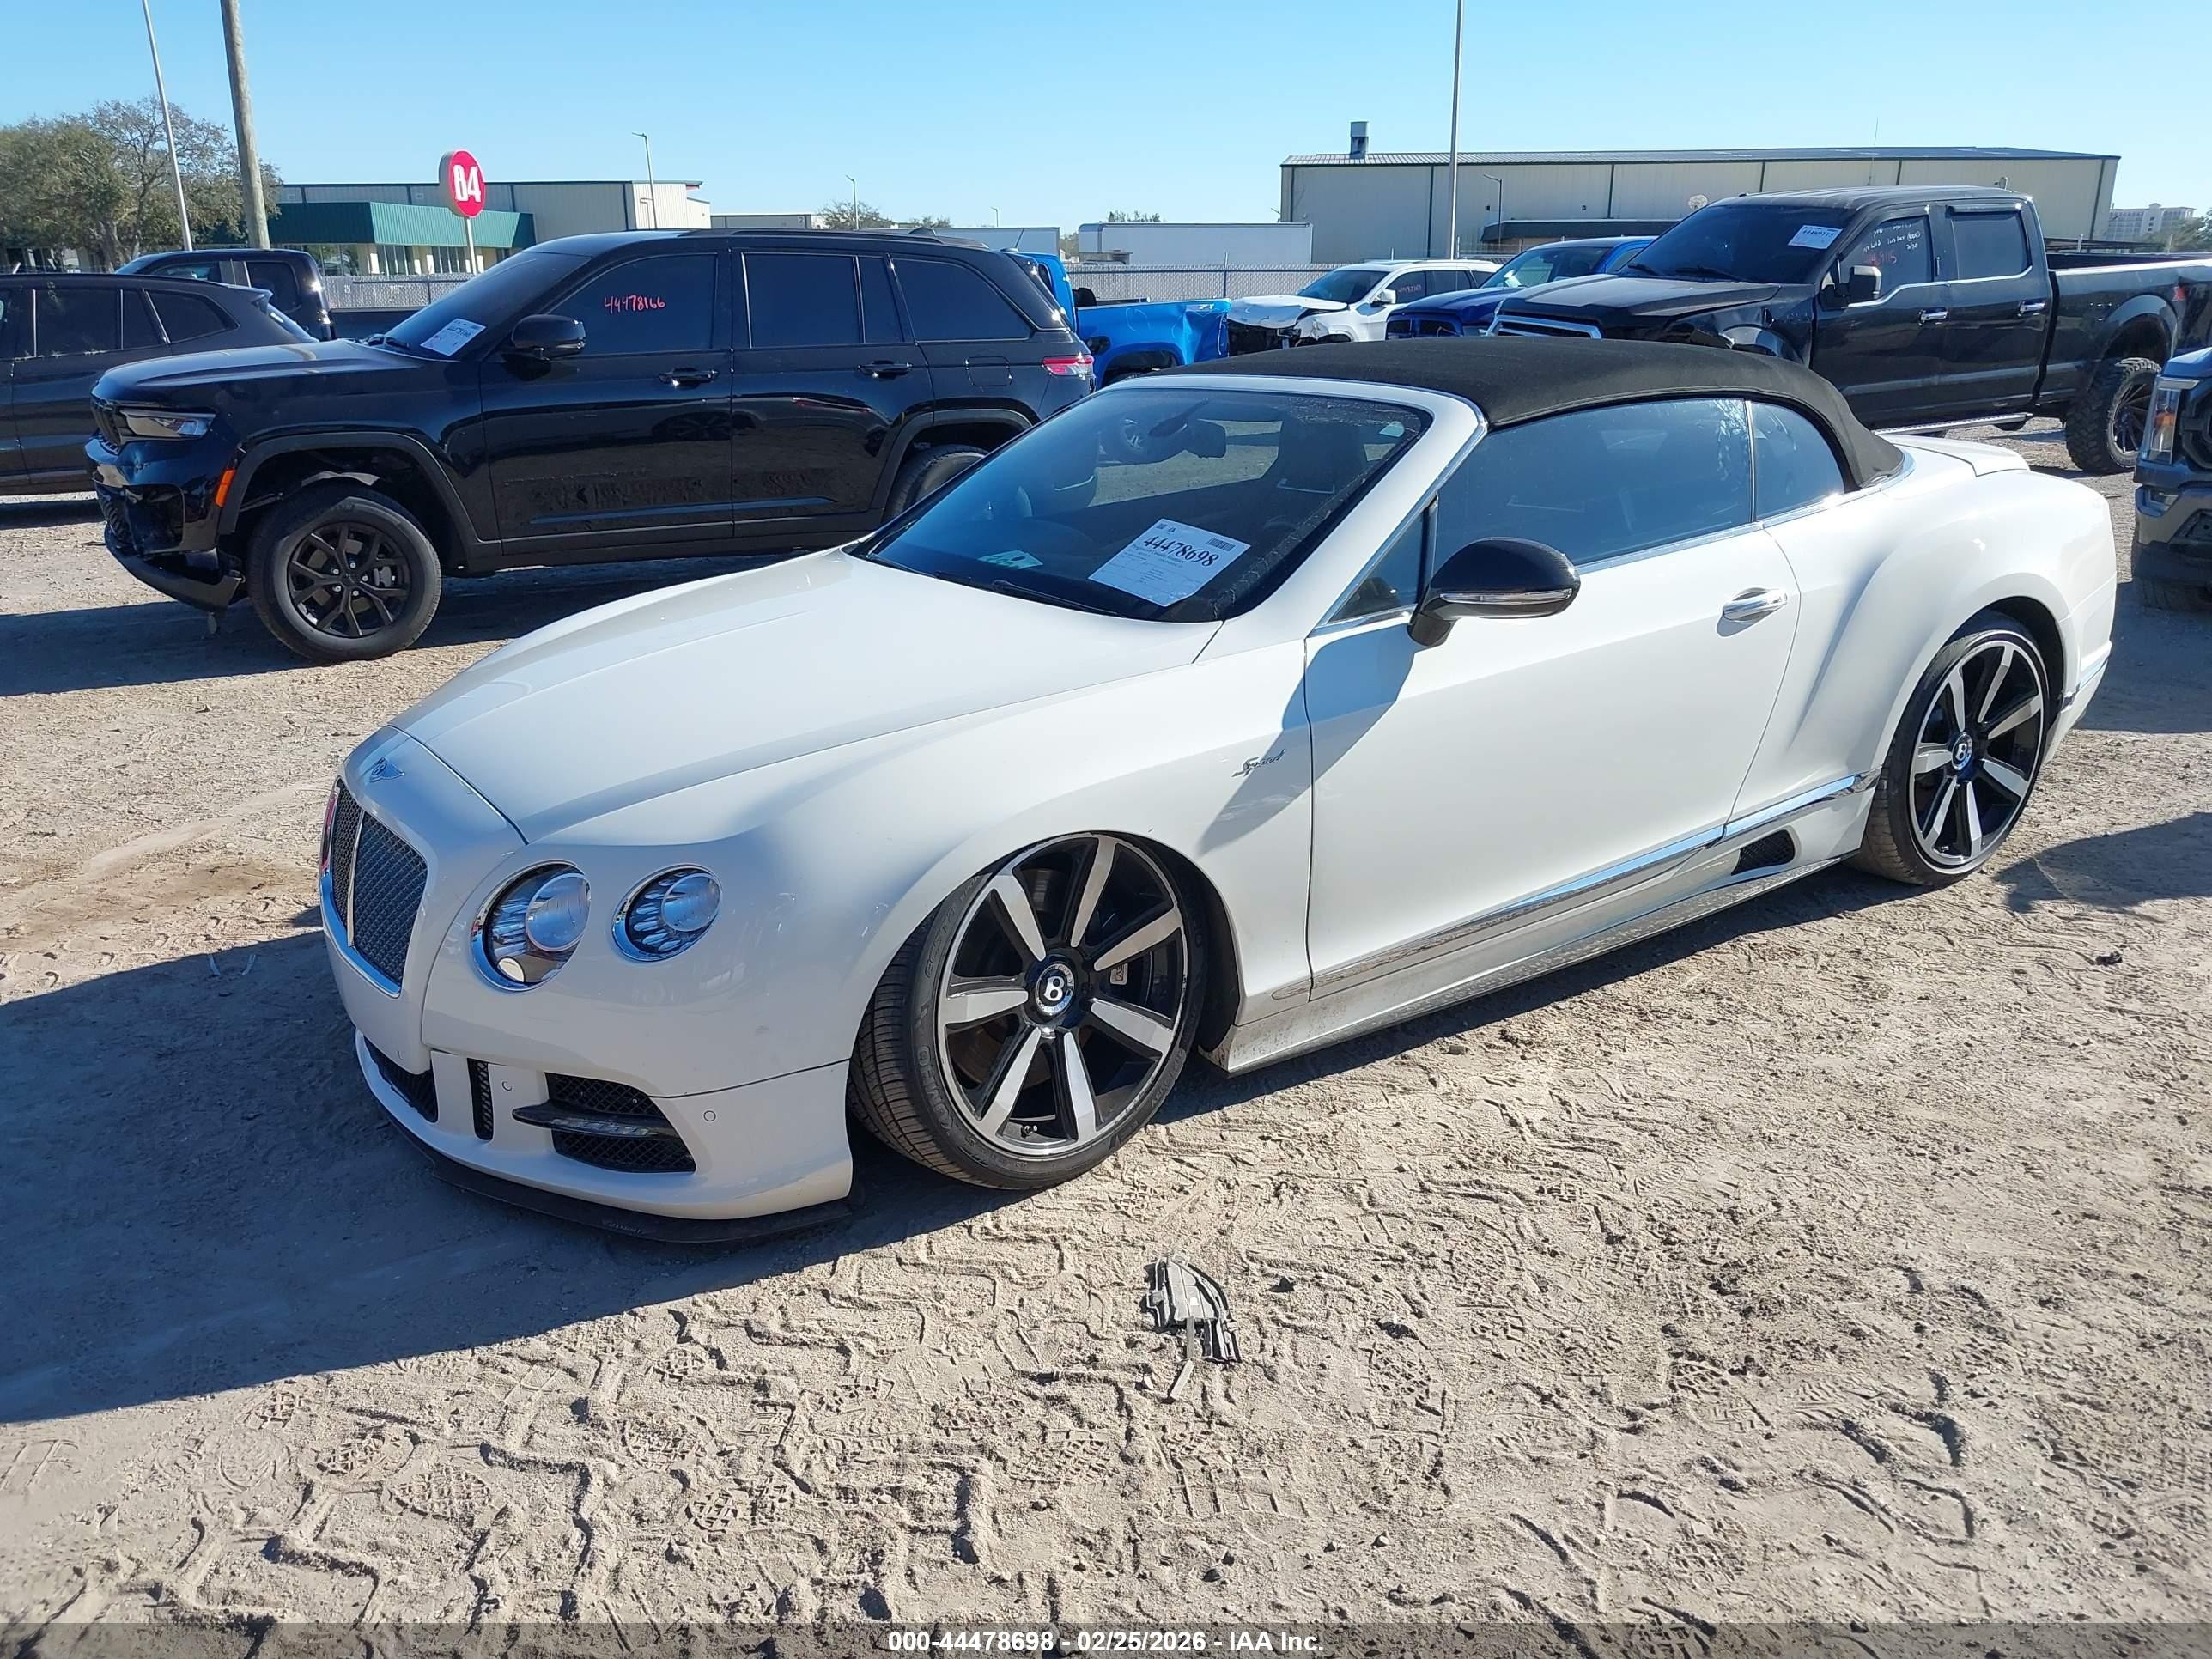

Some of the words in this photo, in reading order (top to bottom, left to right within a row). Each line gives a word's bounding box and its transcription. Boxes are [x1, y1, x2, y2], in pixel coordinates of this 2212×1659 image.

[453, 164, 482, 203] 84
[604, 295, 666, 315] 44478166
[1144, 535, 1219, 567] 44478698
[1043, 975, 1066, 1002] B
